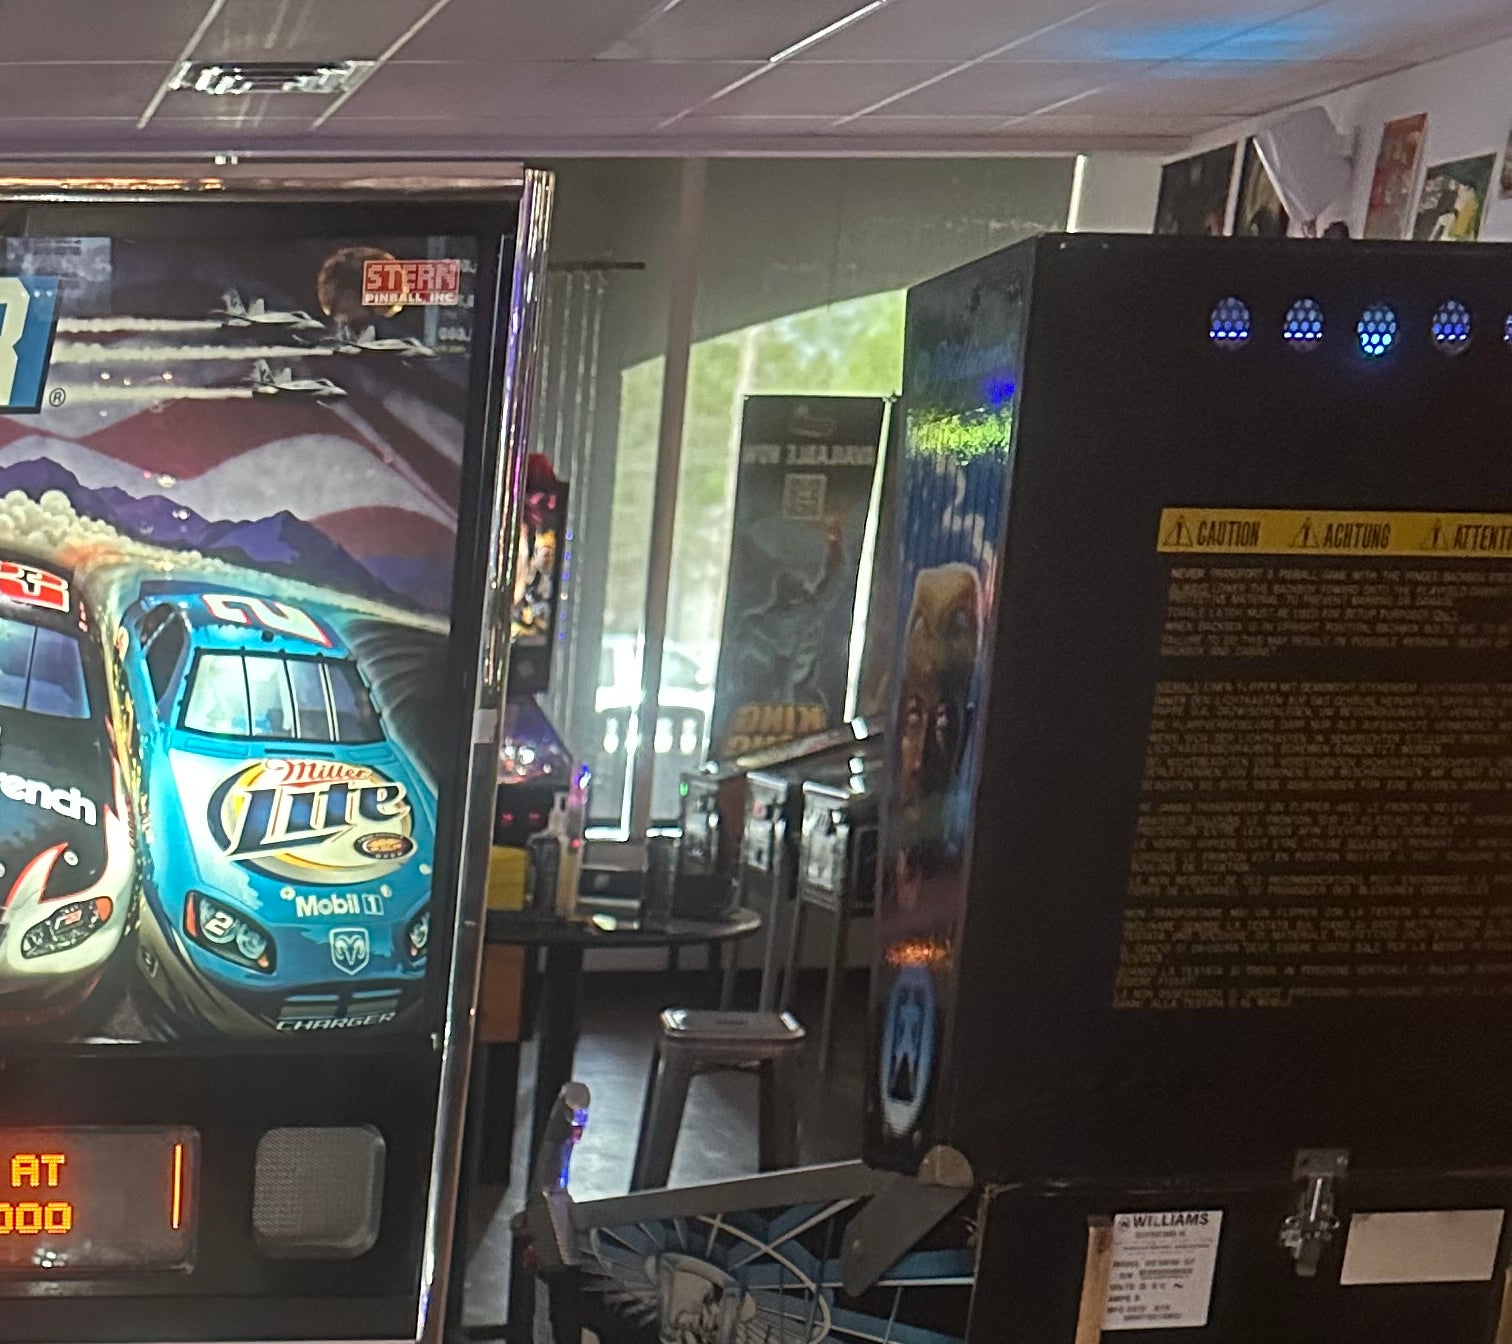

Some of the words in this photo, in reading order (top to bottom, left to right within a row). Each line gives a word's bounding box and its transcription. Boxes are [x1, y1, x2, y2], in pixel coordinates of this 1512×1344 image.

[367, 264, 456, 290] STERN
[1196, 520, 1261, 548] CAUTION
[1324, 522, 1392, 549] ACHTUNG
[266, 758, 373, 784] Miller
[222, 782, 411, 861] Lite
[295, 894, 360, 917] Mobil
[363, 893, 384, 916] 1
[204, 912, 236, 935] 2
[276, 1011, 396, 1032] CHARGER
[11, 1154, 66, 1187] AT
[1132, 1213, 1209, 1228] WILLIAMS
